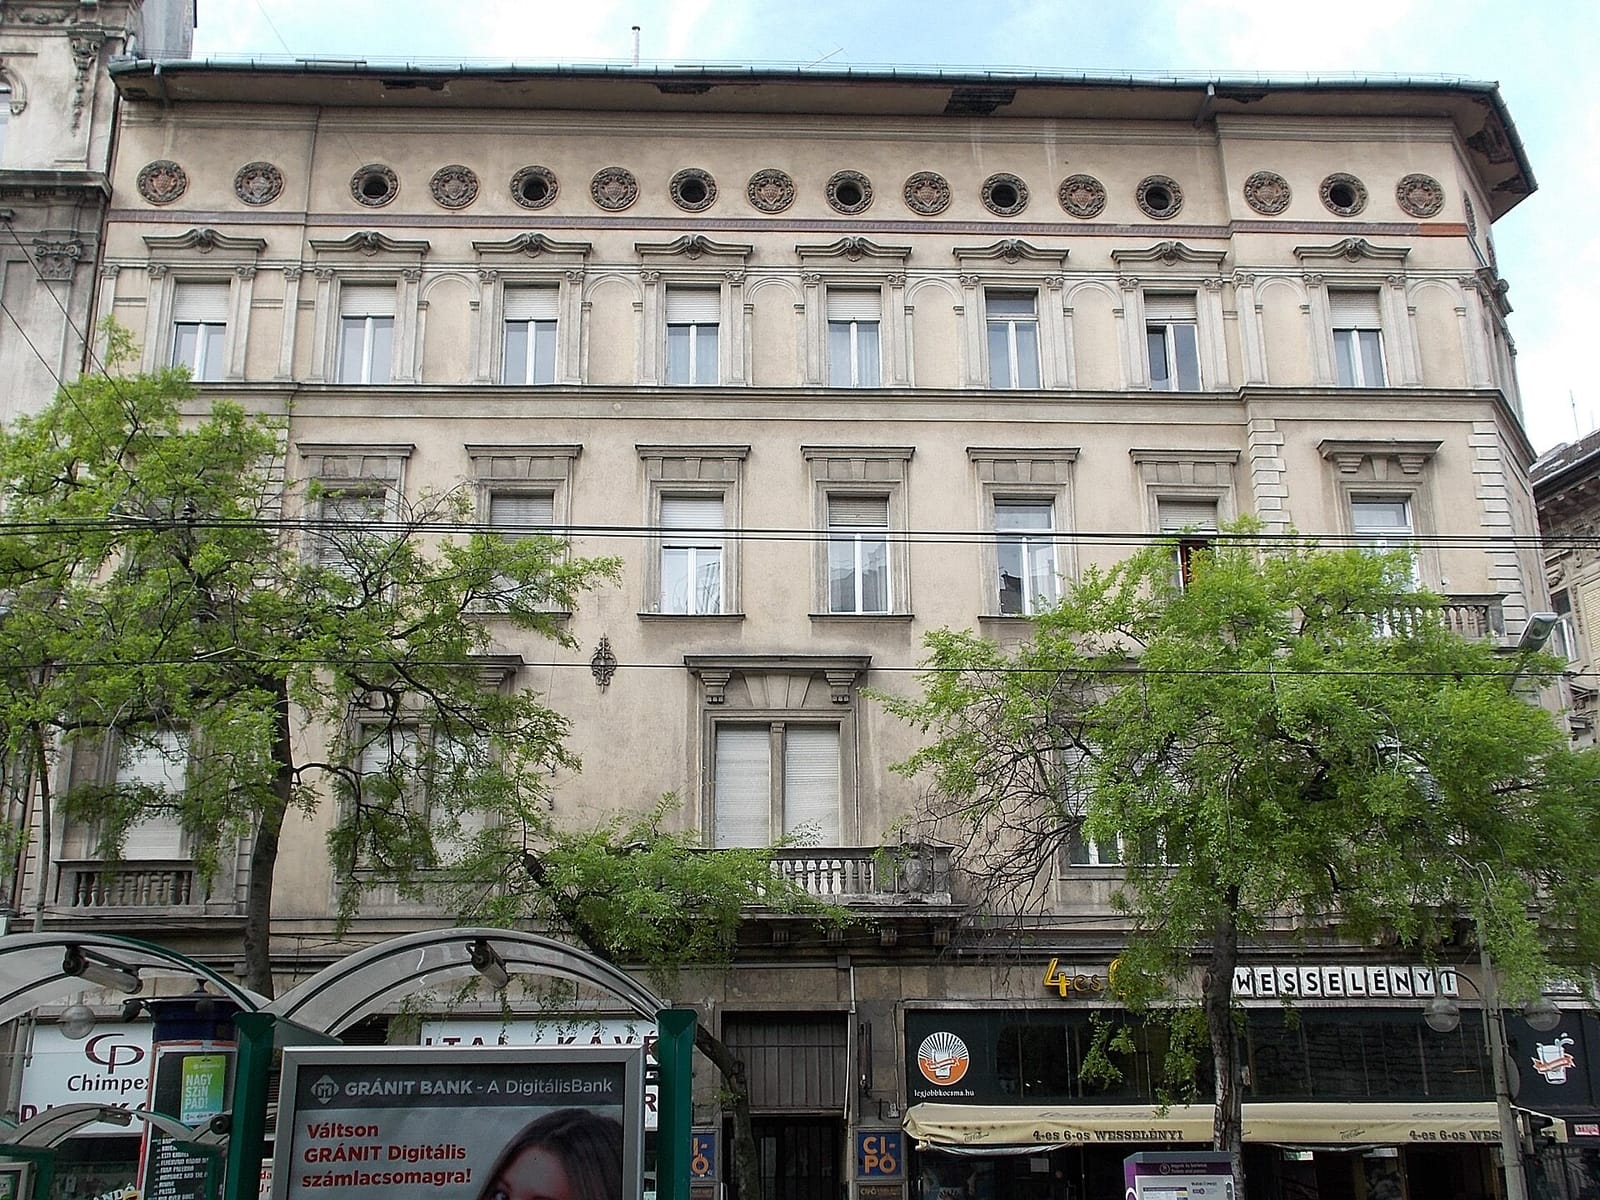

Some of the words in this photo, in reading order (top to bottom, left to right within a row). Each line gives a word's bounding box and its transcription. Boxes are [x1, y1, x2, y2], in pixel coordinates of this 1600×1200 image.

[1237, 969, 1454, 992] WESSELÉNYI
[185, 1073, 213, 1087] NAGY
[345, 1078, 415, 1096] GRÁNIT
[420, 1080, 473, 1095] BANK
[487, 1080, 500, 1094] A
[506, 1078, 613, 1096] DigitálisBank
[307, 1122, 379, 1139] Váltson
[1063, 1130, 1090, 1141] 6-os
[1094, 1128, 1184, 1141] WESSELÉNYI
[1439, 1130, 1466, 1141] 6-os
[304, 1143, 383, 1163] GRÁNIT
[388, 1144, 467, 1163] Digitális
[302, 1168, 472, 1187] számlacsomagra!
